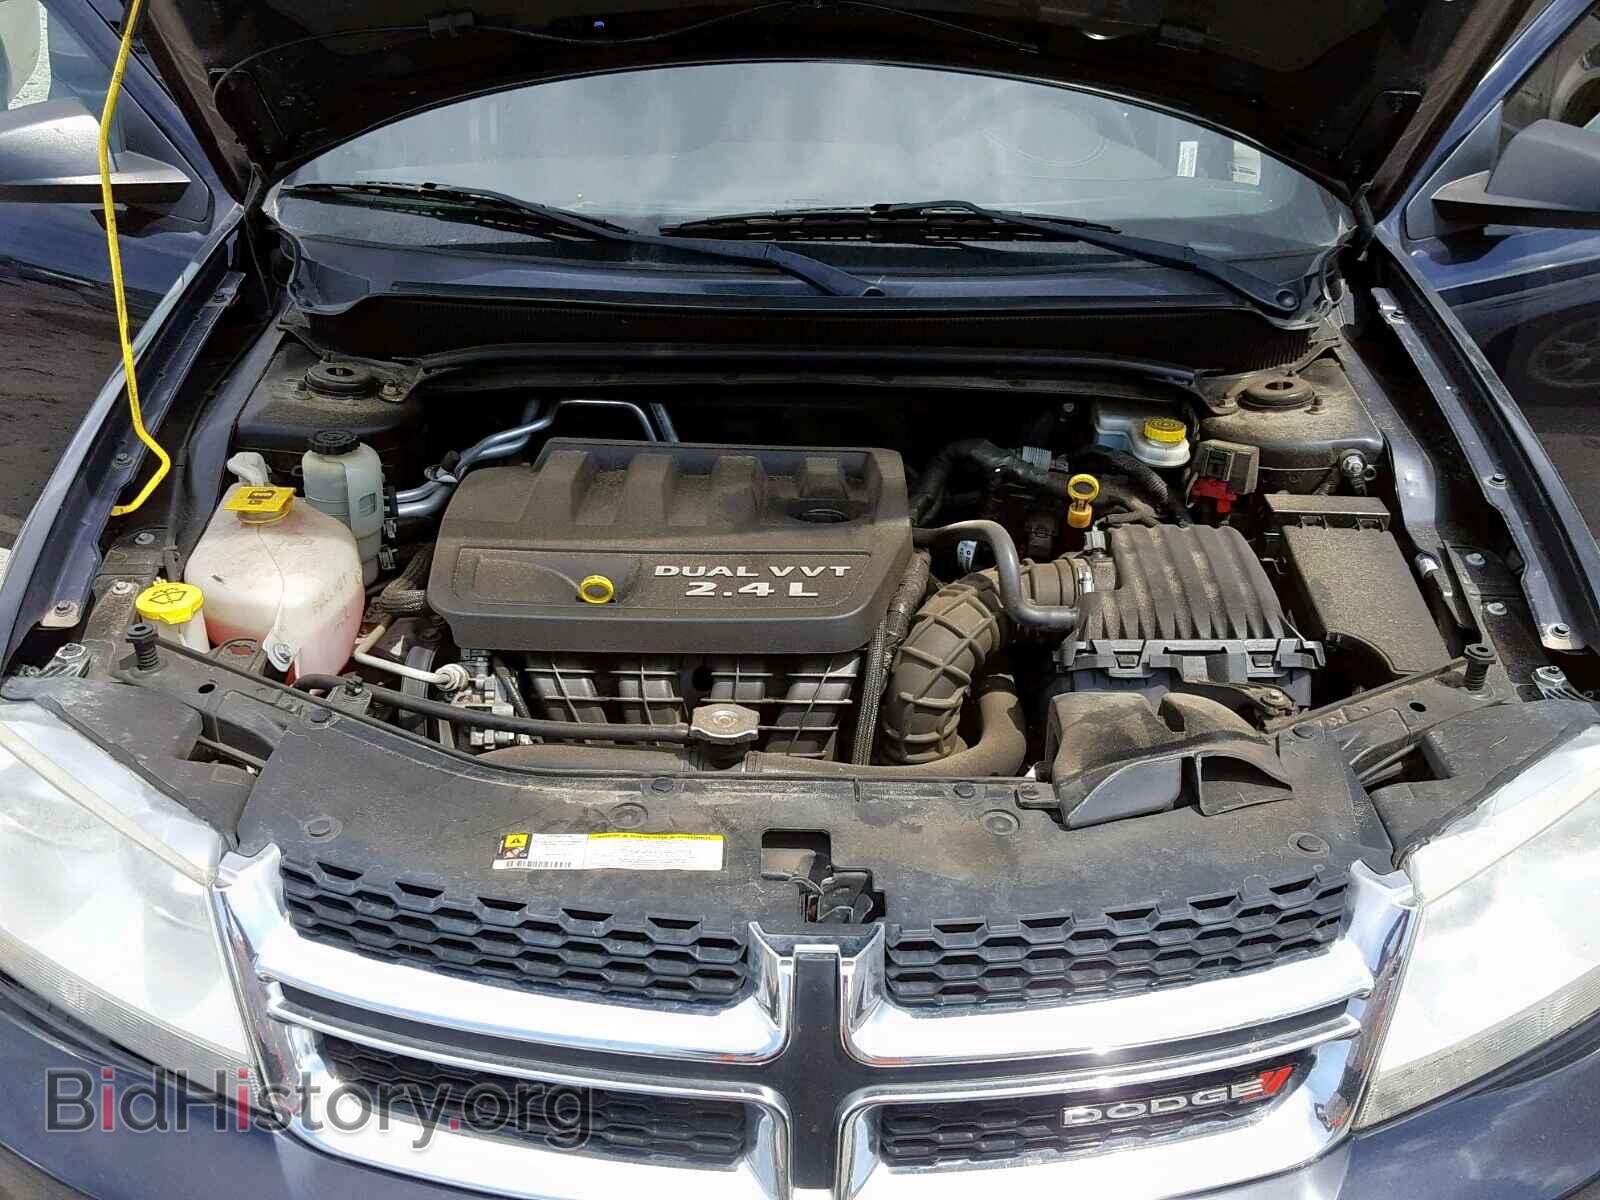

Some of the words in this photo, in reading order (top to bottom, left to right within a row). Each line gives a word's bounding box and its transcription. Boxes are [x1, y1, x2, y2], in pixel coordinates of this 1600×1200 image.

[654, 565, 760, 577] DUAL
[769, 565, 852, 577] VVT
[1062, 1078, 1265, 1126] DODGE
